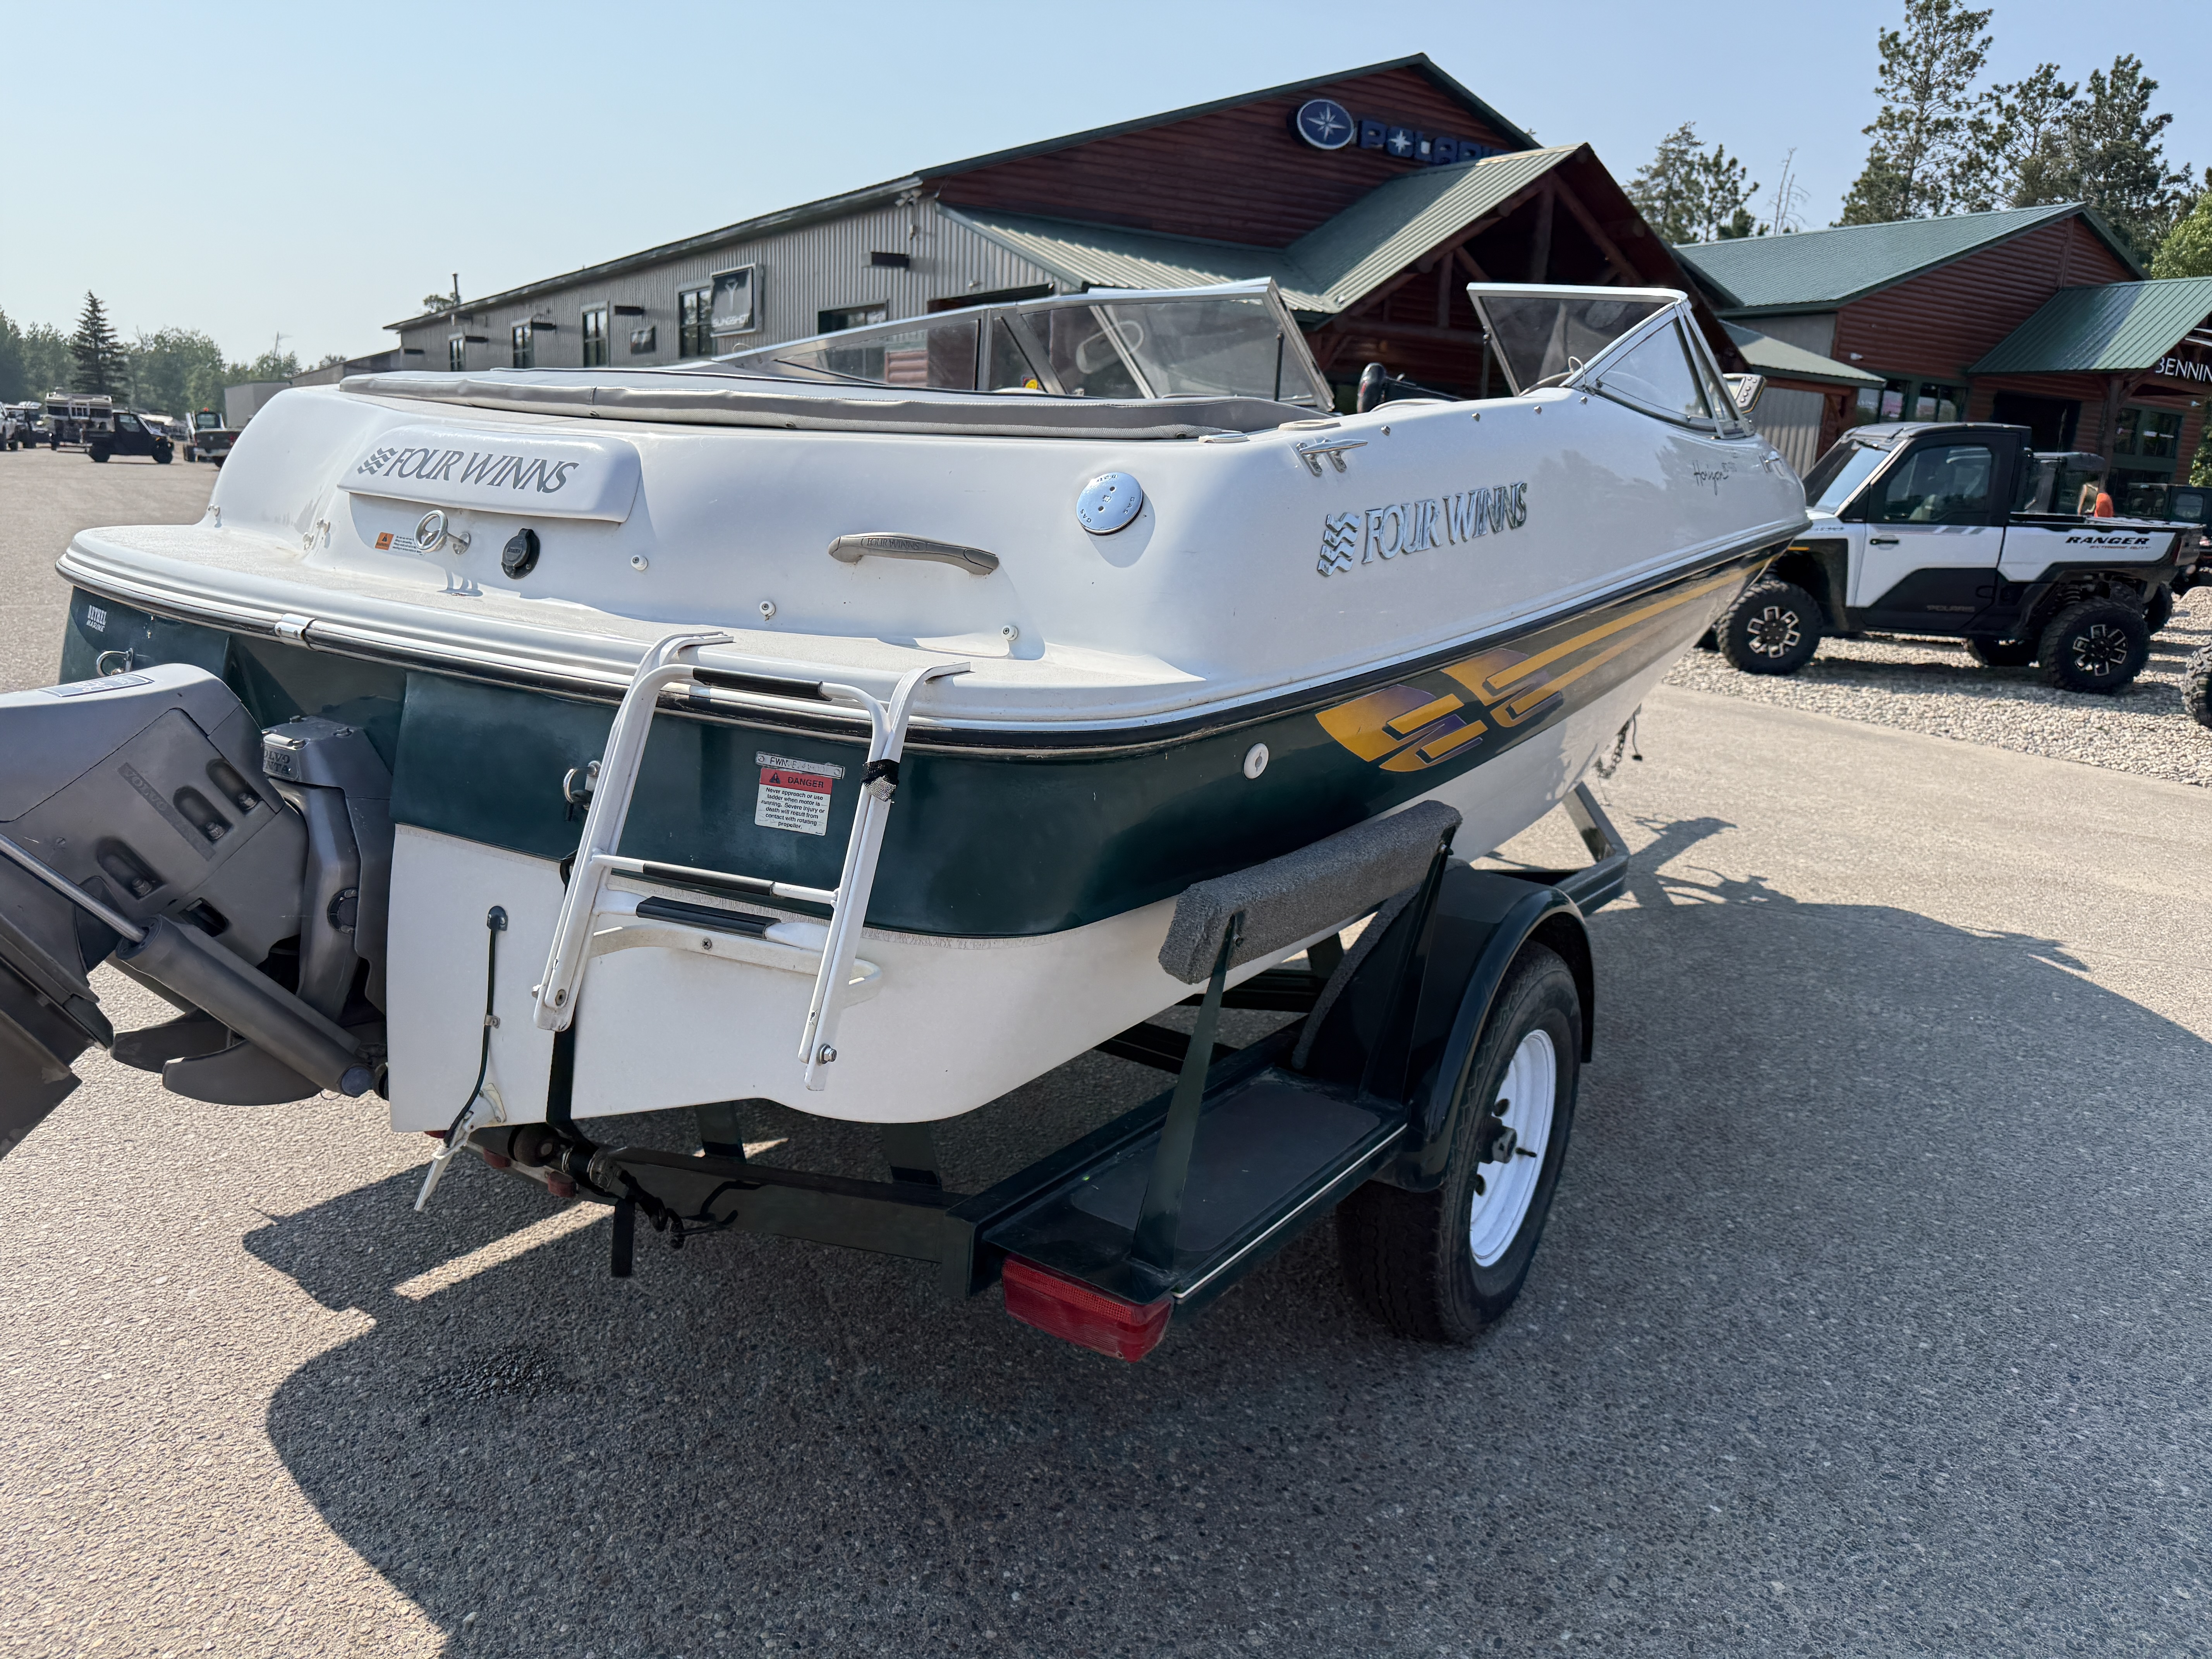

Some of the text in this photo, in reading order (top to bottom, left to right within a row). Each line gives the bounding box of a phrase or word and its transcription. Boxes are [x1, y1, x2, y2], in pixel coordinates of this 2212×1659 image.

[383, 448, 579, 494] FOUR WINNS
[1080, 509, 1092, 523] GAS
[1361, 481, 1527, 564] FOUR WINNS
[867, 538, 919, 550] FOUR WINNS
[88, 605, 107, 625] BETHEL
[86, 619, 105, 632] MARINE
[788, 776, 824, 788] DANGER
[125, 768, 168, 811] VOLVO
[761, 800, 782, 808] running.
